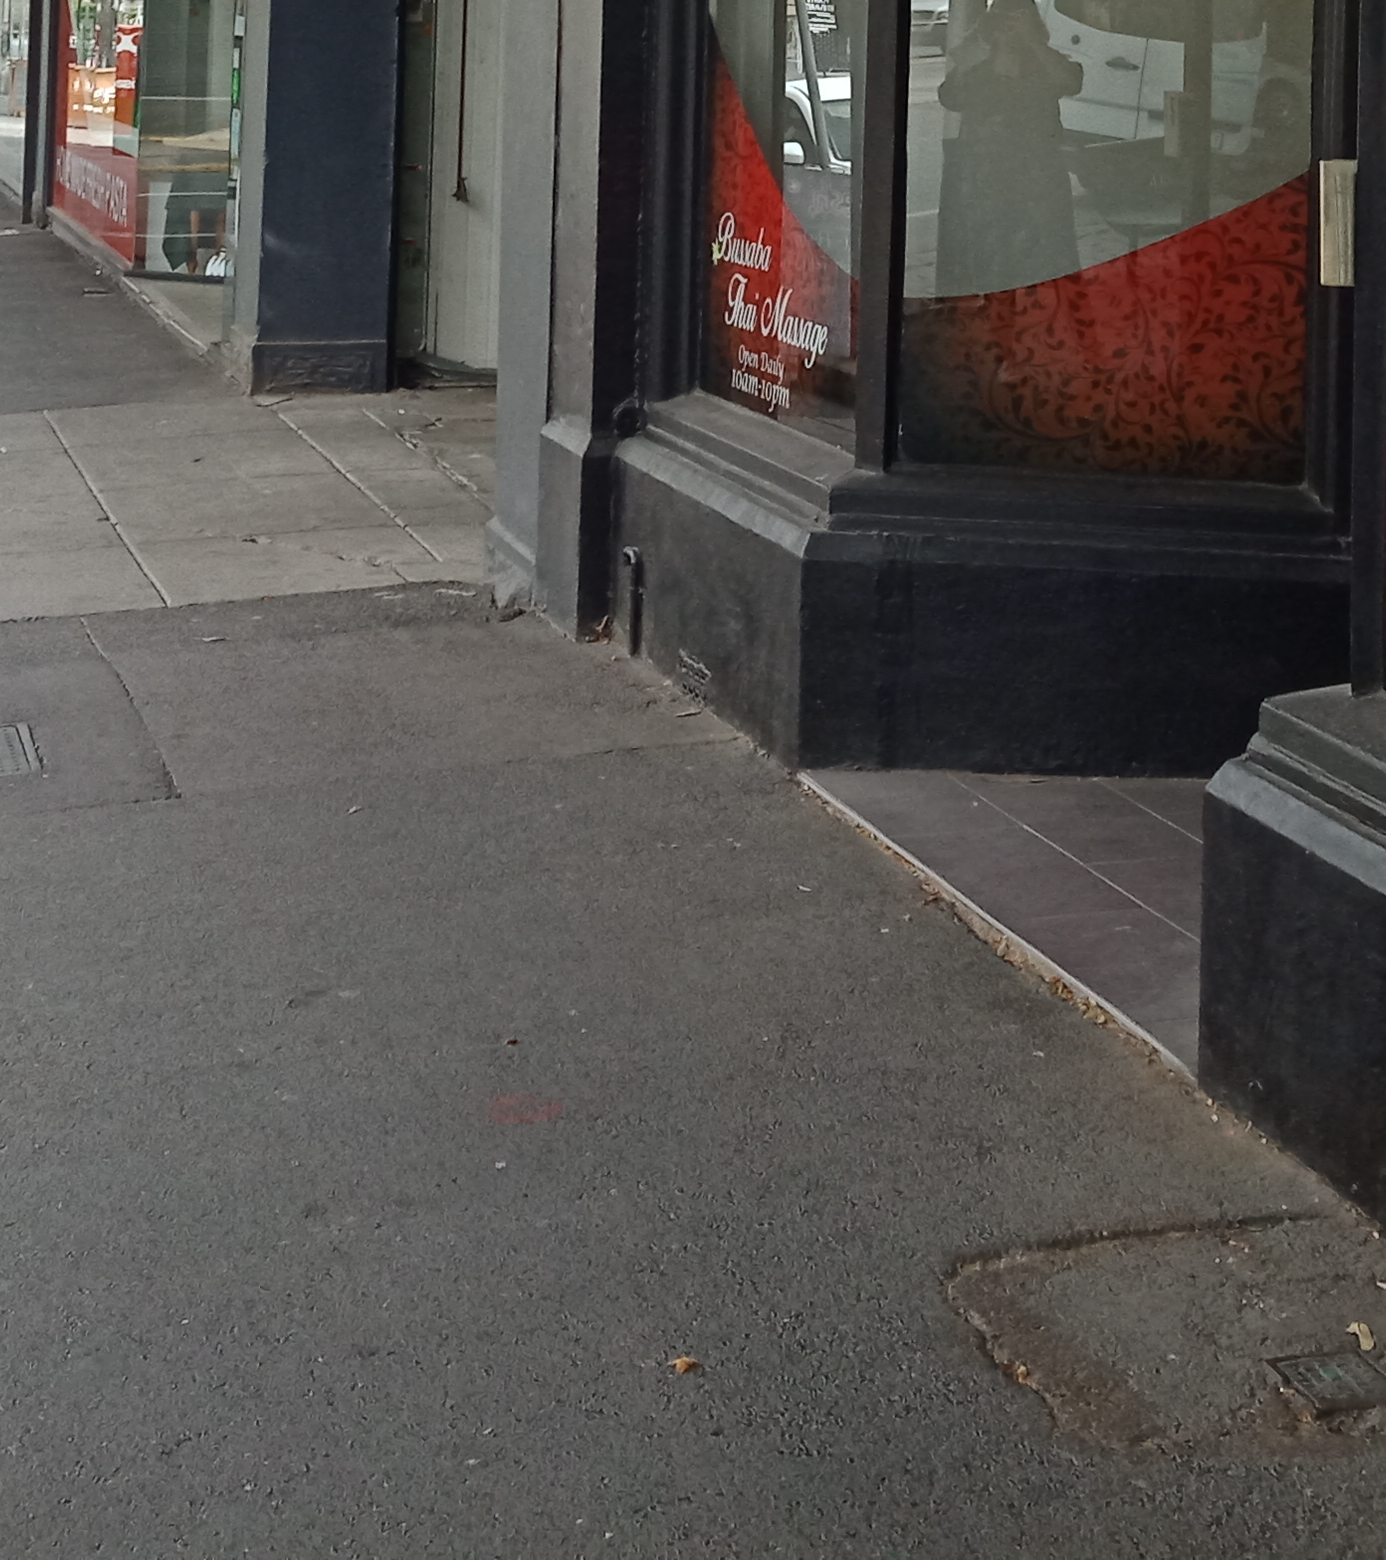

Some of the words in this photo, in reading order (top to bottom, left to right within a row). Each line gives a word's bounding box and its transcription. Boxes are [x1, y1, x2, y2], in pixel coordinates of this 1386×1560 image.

[718, 212, 772, 272] Bussaba
[724, 273, 760, 333] Thai
[760, 285, 829, 370] Massage
[738, 344, 759, 373] Open
[760, 351, 785, 385] Daily
